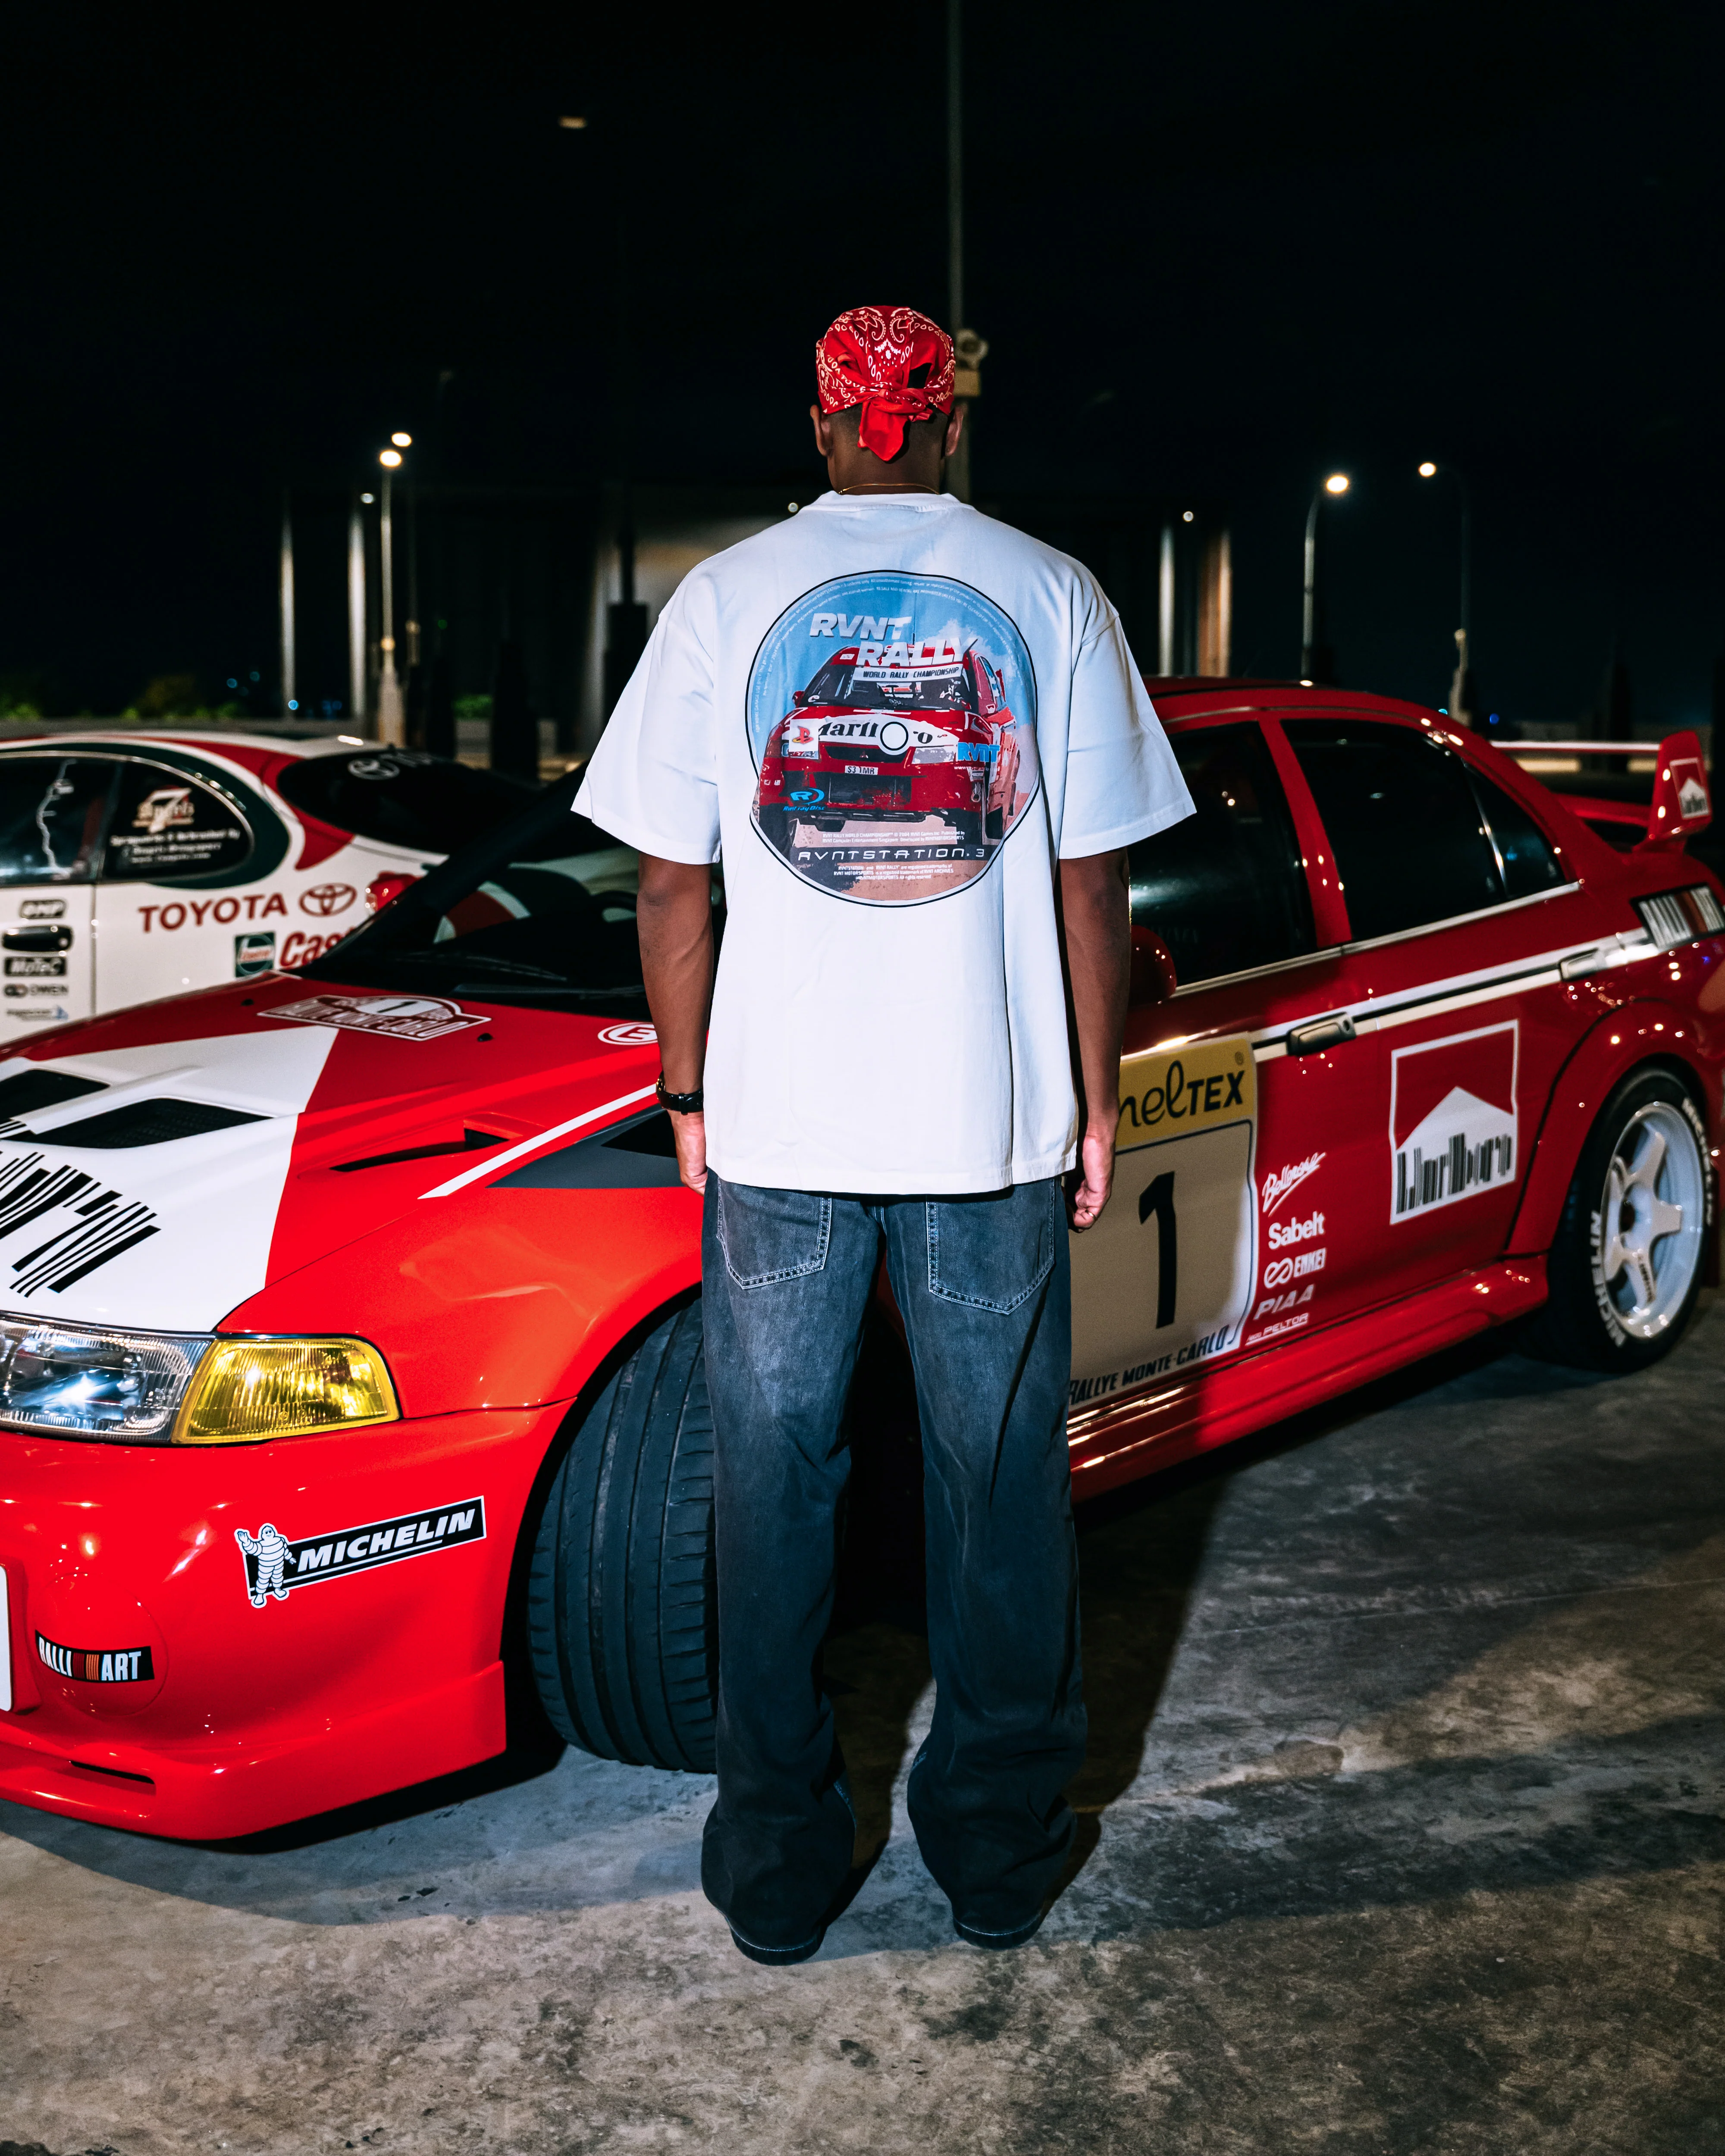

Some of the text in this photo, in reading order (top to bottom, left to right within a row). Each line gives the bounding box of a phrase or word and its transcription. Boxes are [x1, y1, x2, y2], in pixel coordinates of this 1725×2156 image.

[809, 612, 912, 641] RVNT
[856, 637, 978, 667] RALLY
[913, 667, 960, 678] CHAMPIONSHIP
[137, 892, 289, 934] TOYOTA
[1268, 1210, 1325, 1250] Sabelt
[1139, 1171, 1177, 1329] 1
[1252, 1283, 1315, 1320] PIAA
[1263, 1313, 1308, 1336] PELTOR
[1069, 1372, 1119, 1405] RALLYE
[297, 1508, 475, 1573] MICHELIN
[39, 1636, 141, 1681] RALLI ART
